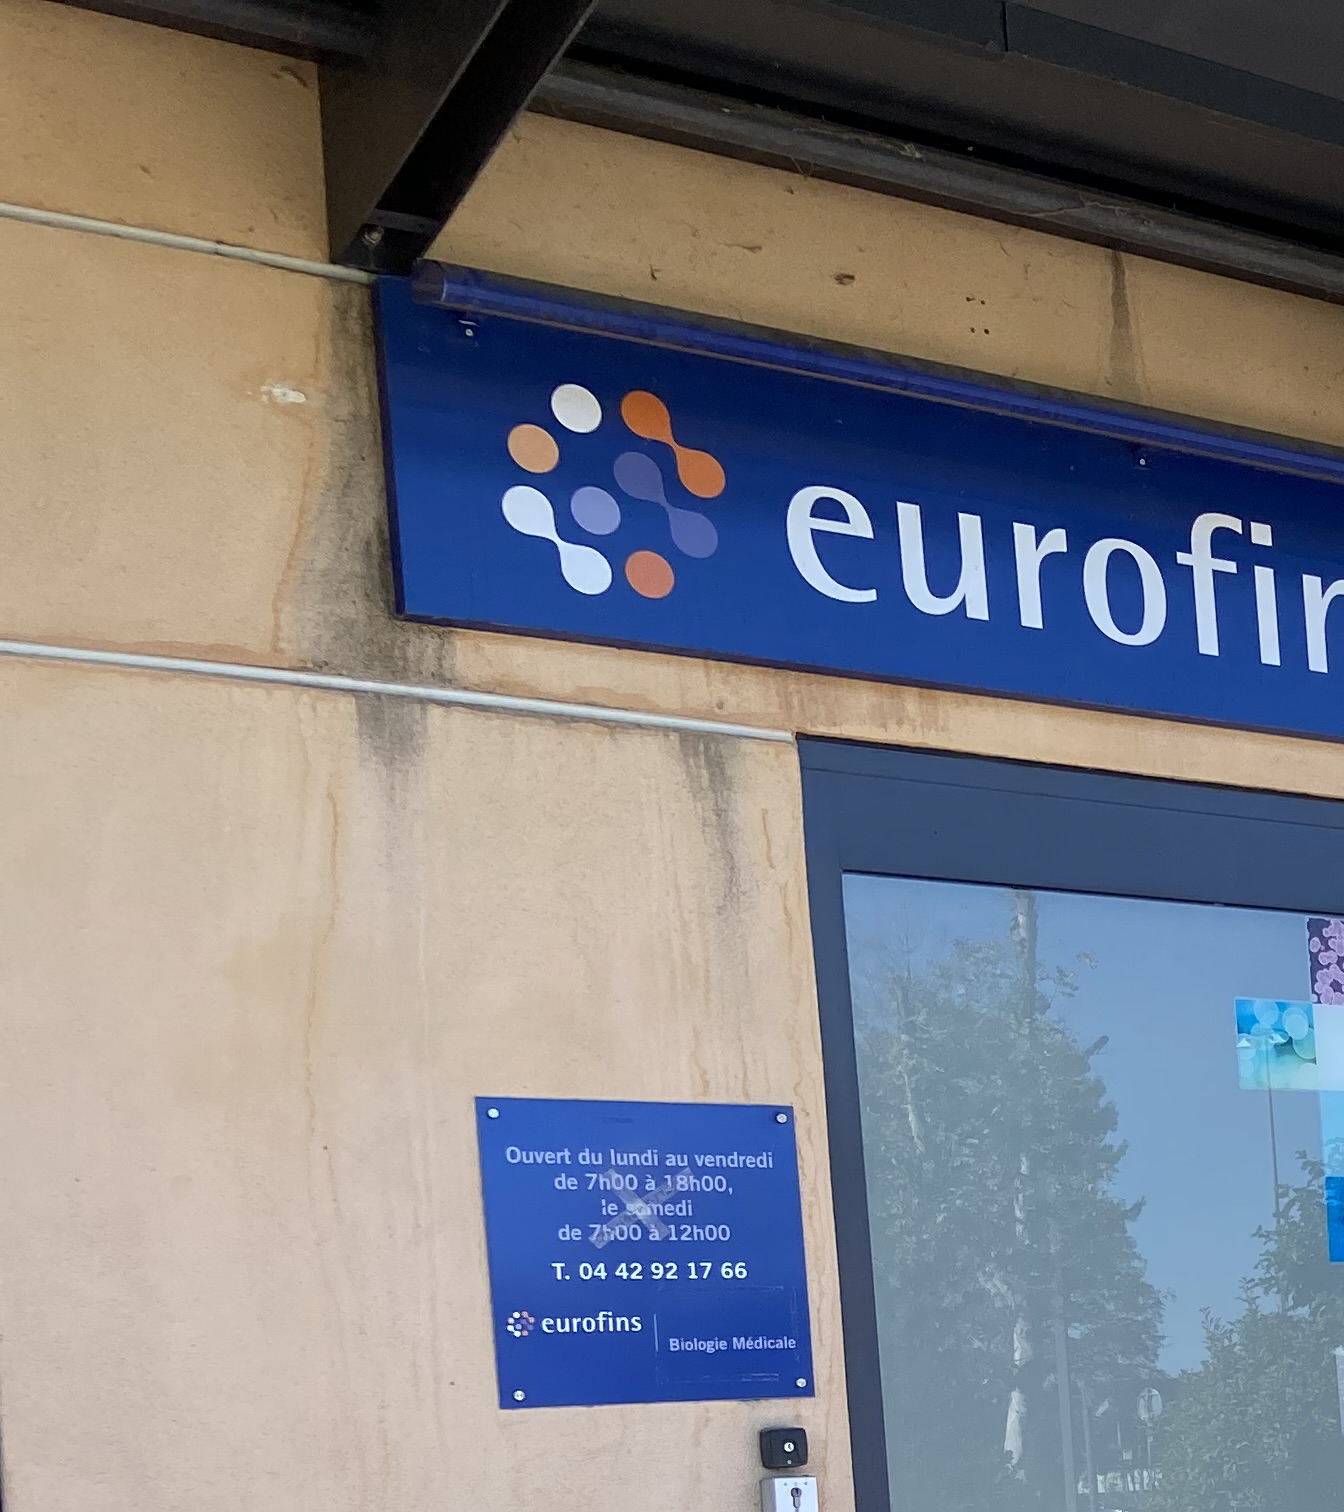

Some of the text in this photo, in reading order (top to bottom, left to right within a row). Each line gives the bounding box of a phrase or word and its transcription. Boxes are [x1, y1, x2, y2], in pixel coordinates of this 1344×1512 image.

[506, 1146, 774, 1169] Ouvert du lundi au vendredi
[554, 1173, 733, 1195] de 7h00 à 18h00,
[601, 1199, 619, 1216] le
[559, 1223, 731, 1241] de 7h00 à 12h00
[552, 1261, 748, 1280] T. 04 42 92 17 66
[542, 1311, 642, 1334] eurofins
[669, 1335, 797, 1353] Biologie Médicale
